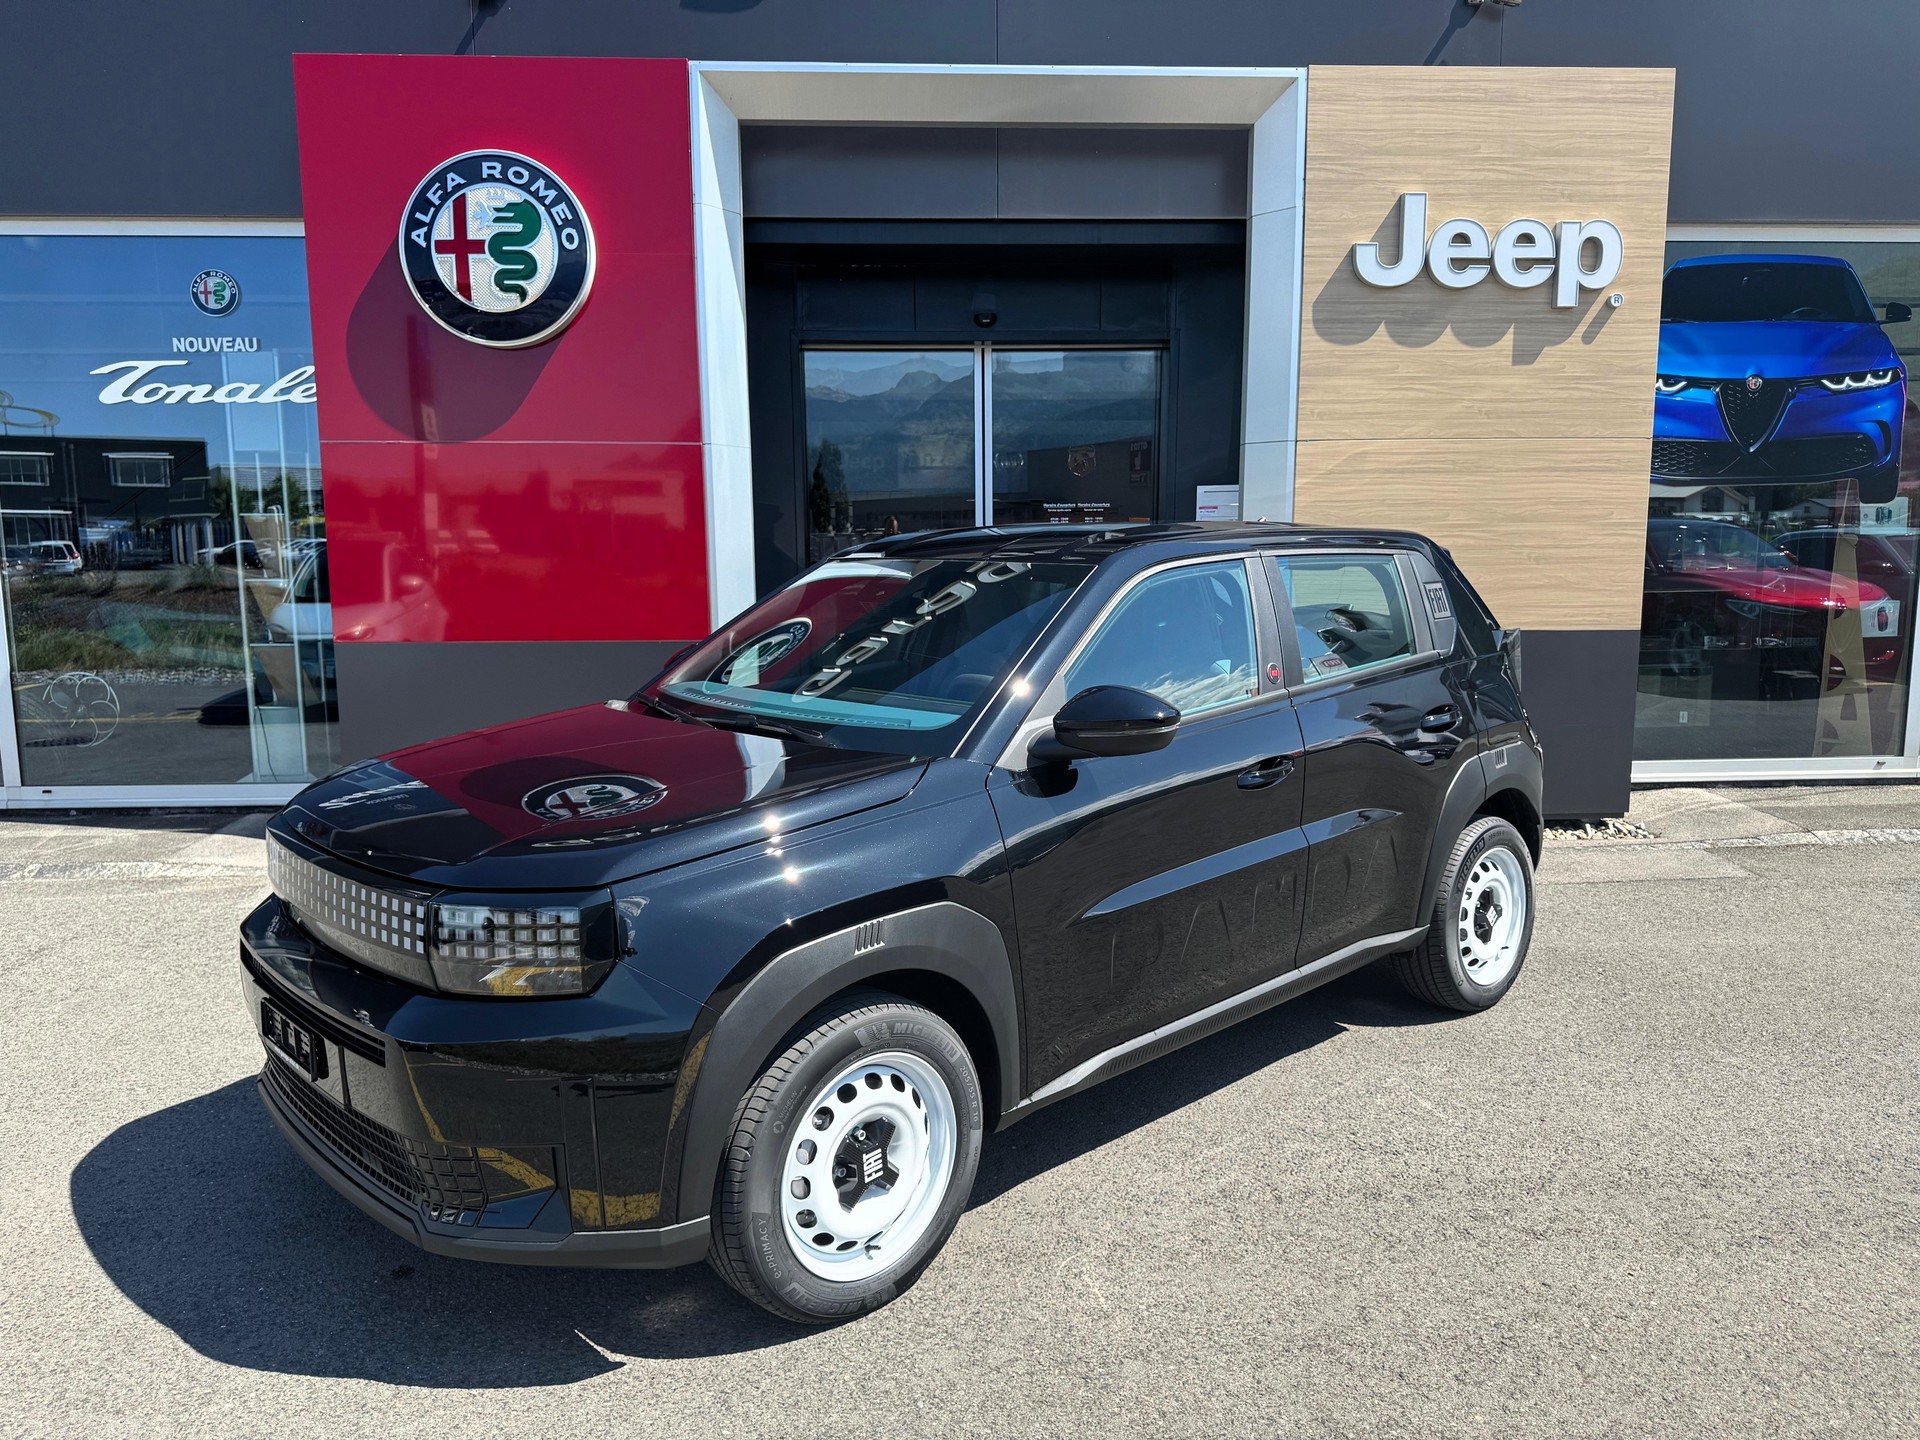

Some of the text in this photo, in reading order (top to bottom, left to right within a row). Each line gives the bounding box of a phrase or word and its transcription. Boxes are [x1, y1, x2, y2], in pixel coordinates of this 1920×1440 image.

[411, 161, 580, 250] ALFA ROMEO
[1352, 191, 1624, 308] Jeep
[192, 271, 236, 294] ALFA ROMEO
[172, 337, 259, 353] NOUVEAU
[89, 360, 318, 405] Tonale
[1428, 587, 1449, 614] FIAT
[893, 1022, 958, 1060] MICHELIN
[959, 1065, 976, 1099] 205/55
[862, 1148, 884, 1184] FIAT
